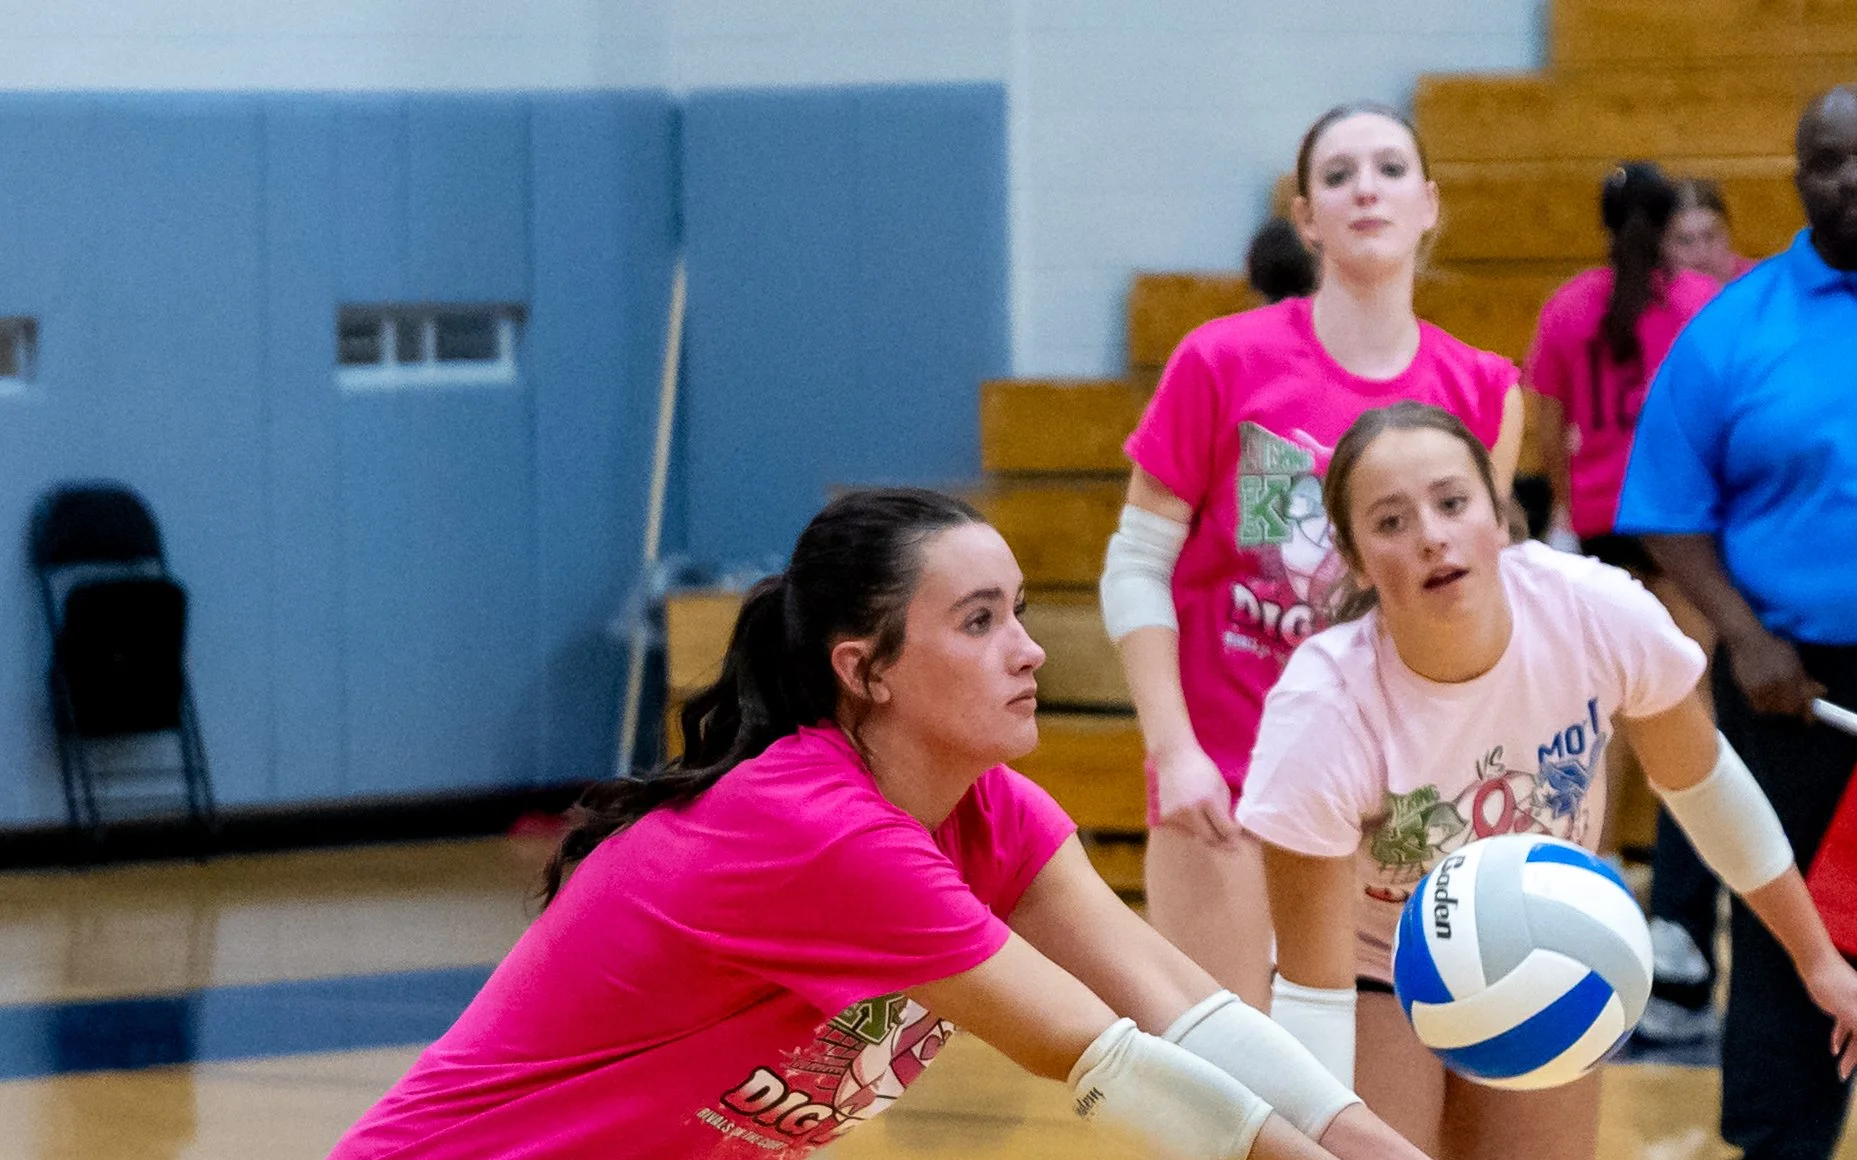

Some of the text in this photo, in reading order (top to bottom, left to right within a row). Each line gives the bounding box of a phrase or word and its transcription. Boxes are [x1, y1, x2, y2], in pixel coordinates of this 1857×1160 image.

[1238, 474, 1293, 546] K
[1434, 855, 1466, 940] Baden
[696, 1107, 736, 1134] RIVALS
[720, 1065, 837, 1137] DIG
